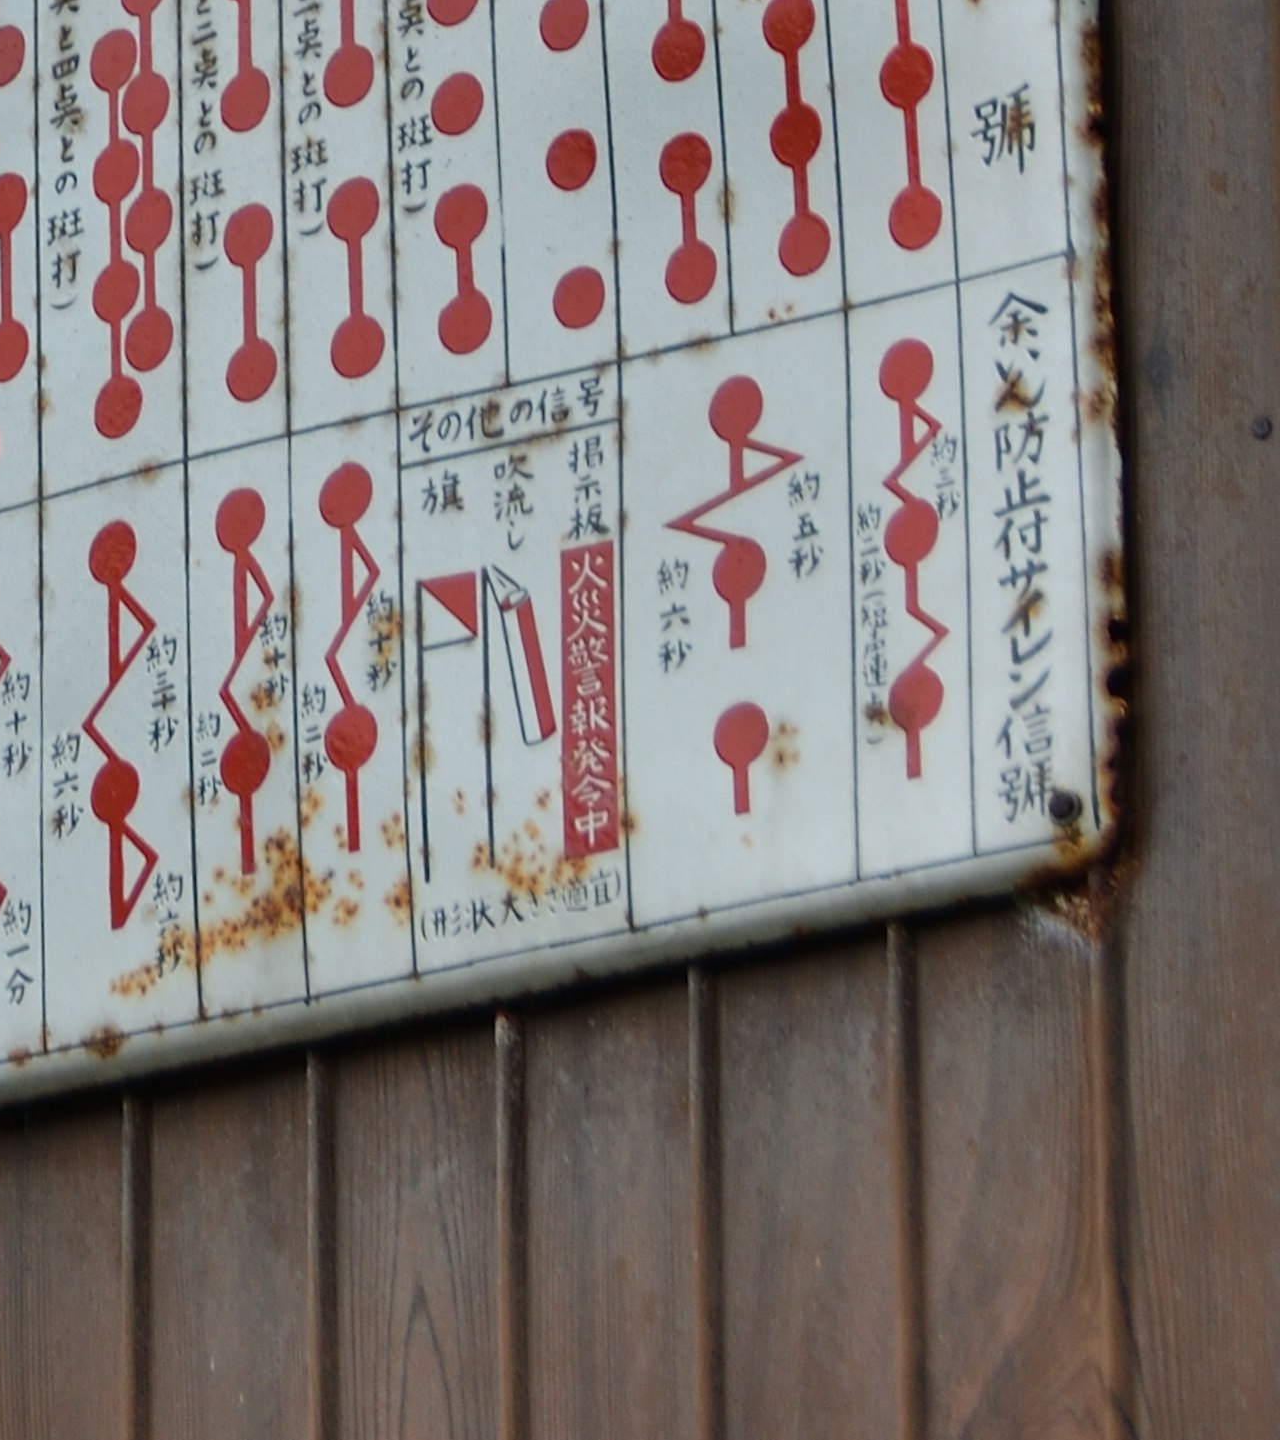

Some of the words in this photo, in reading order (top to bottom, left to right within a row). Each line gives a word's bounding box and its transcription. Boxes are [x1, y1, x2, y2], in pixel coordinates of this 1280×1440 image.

[408, 376, 606, 448] その他の信号
[421, 470, 464, 516] 旗
[493, 445, 538, 552] 吹流し
[788, 472, 823, 579] 約五秒
[256, 613, 289, 708] 約十秒
[365, 585, 402, 692] 約十秒
[658, 559, 692, 673] 約六秒
[0, 672, 33, 778] 約十秒
[144, 634, 179, 753] 約三十秒
[301, 684, 328, 785] 約二秒
[566, 552, 612, 846] 火災警報発令中
[50, 725, 86, 840] 約六秒
[196, 712, 222, 806] 約二秒
[1, 899, 34, 1005] 約一分
